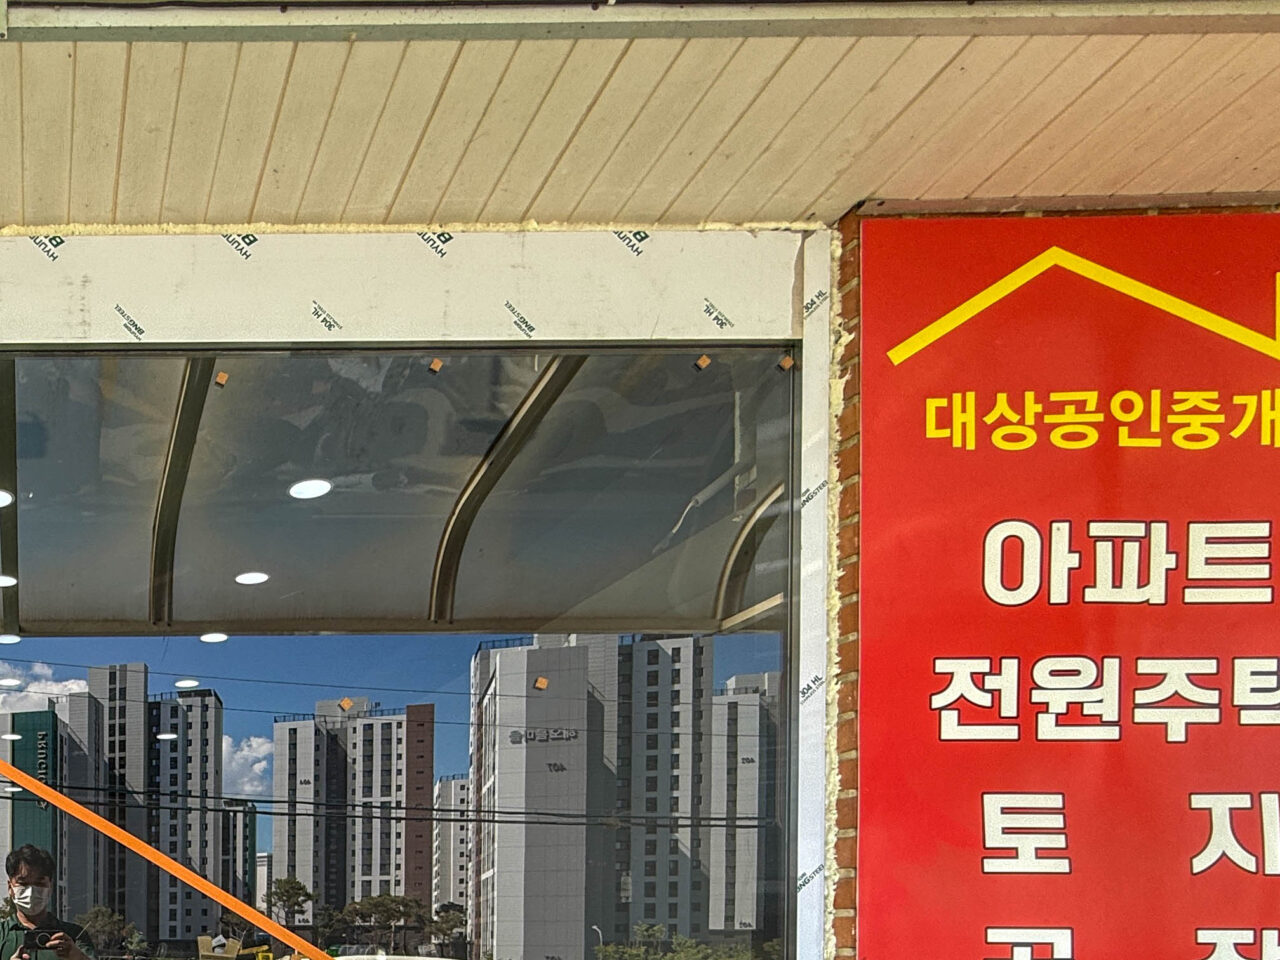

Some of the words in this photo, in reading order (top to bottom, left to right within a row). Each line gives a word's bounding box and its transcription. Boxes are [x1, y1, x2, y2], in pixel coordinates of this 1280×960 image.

[28, 235, 58, 262] HYUN
[221, 233, 252, 260] HYUN
[416, 231, 446, 258] HYUN
[612, 230, 643, 257] HYUN
[814, 289, 828, 302] HL
[924, 386, 1280, 451] 대상공인중개
[982, 518, 1275, 607] 아파트
[811, 674, 824, 688] HL
[981, 792, 1072, 875] 토
